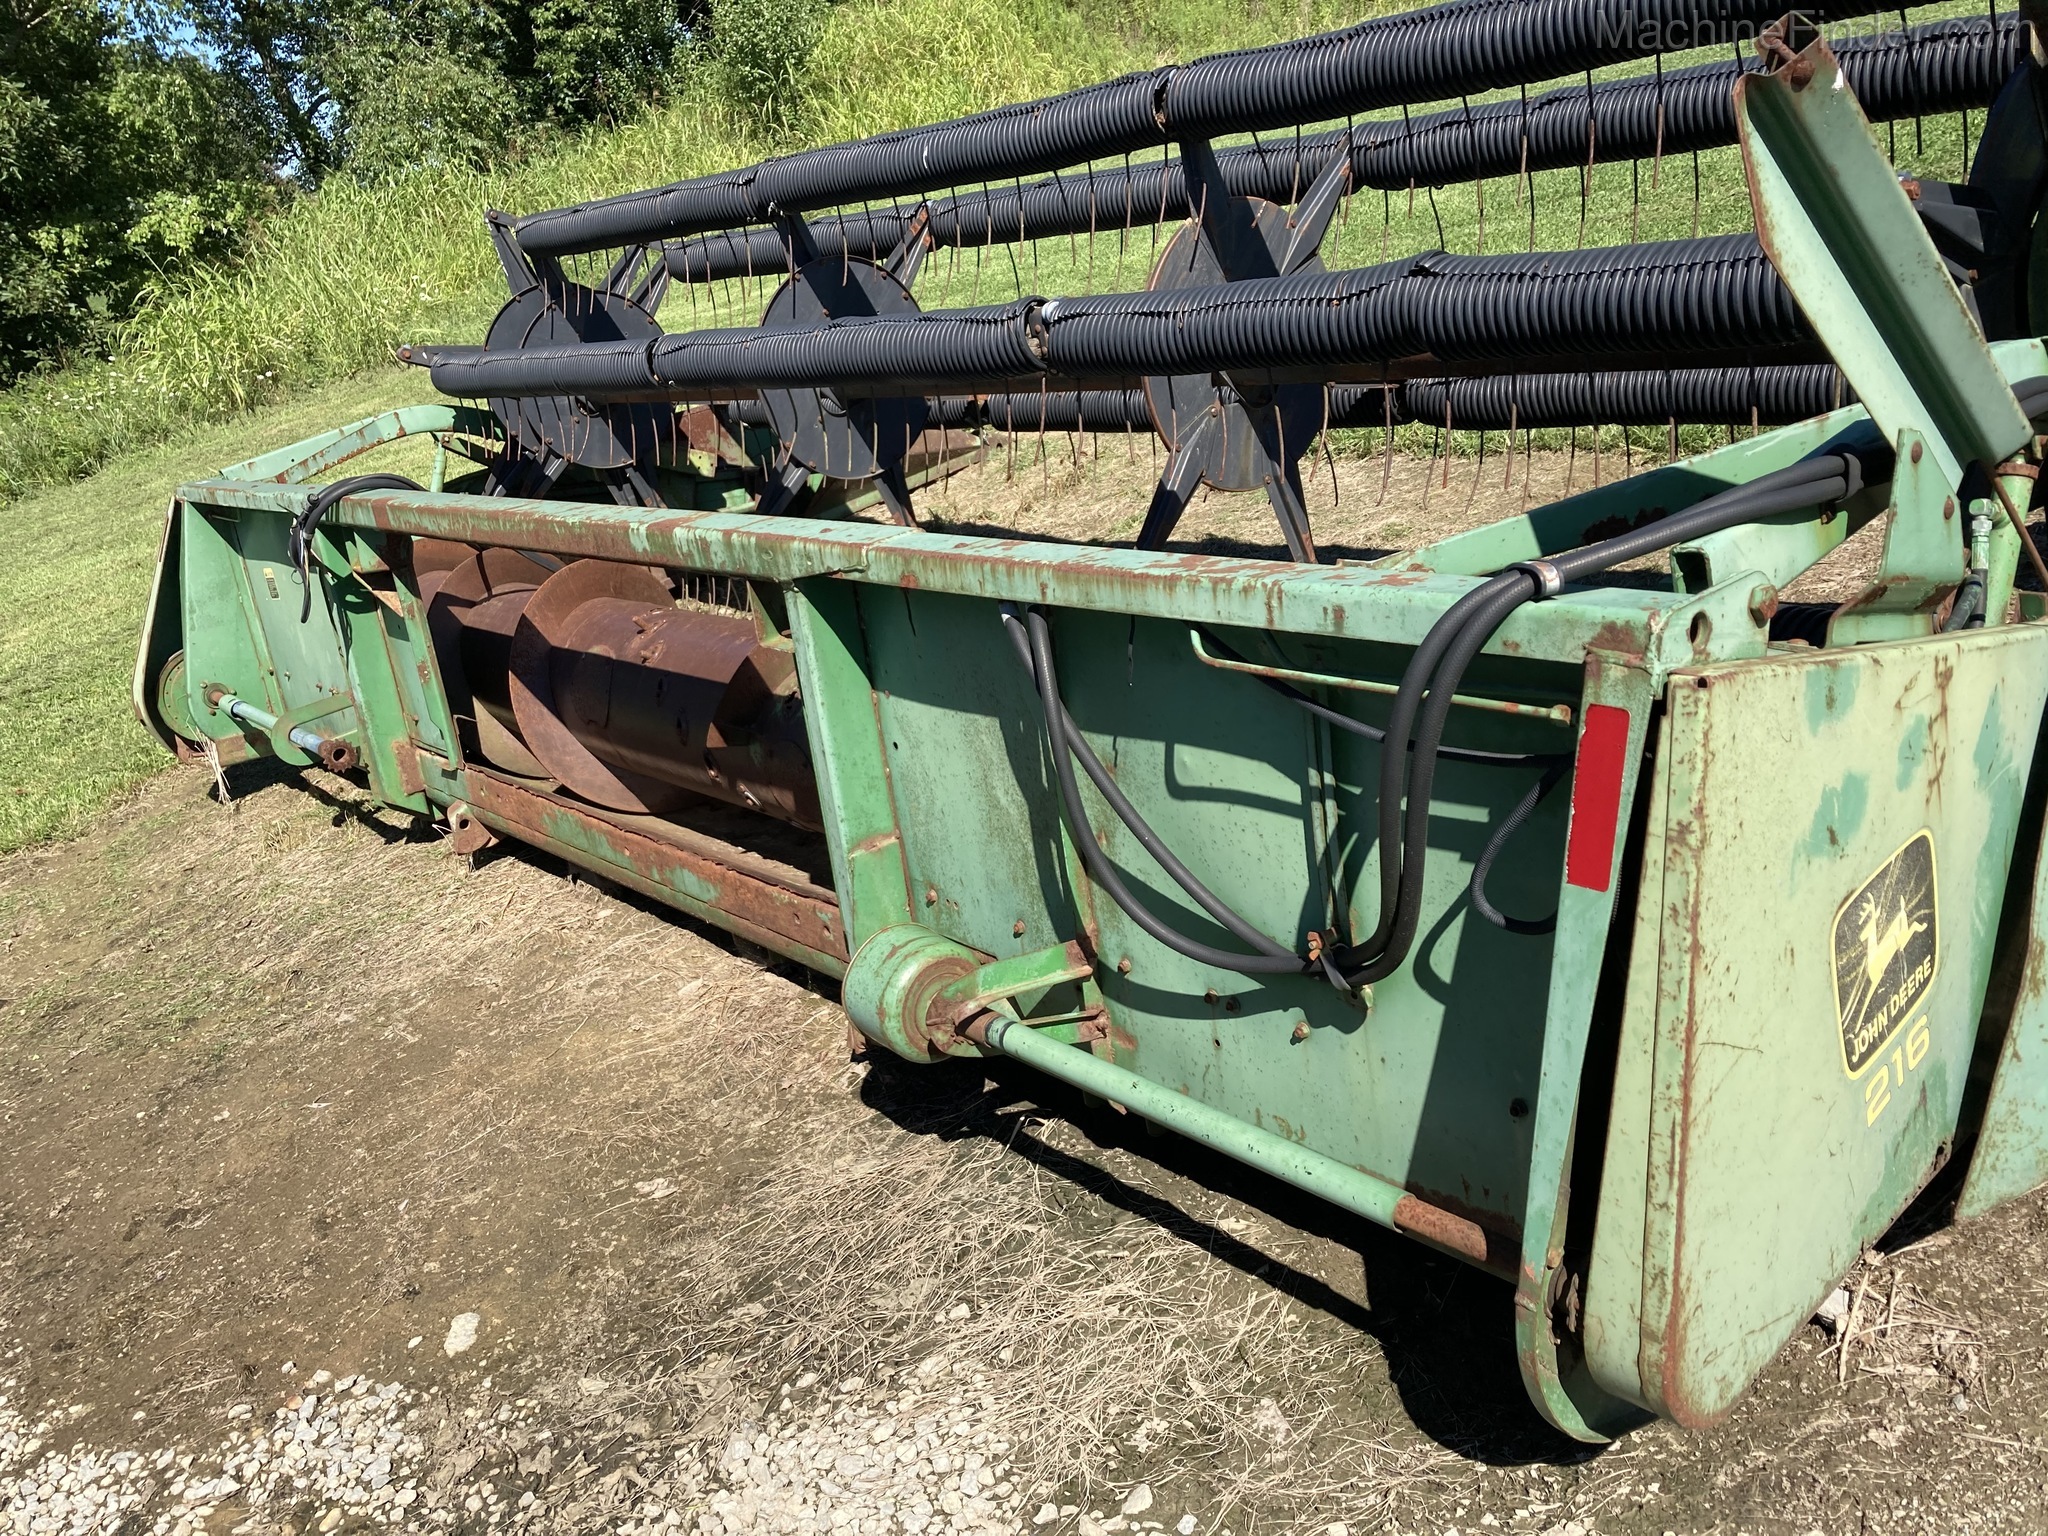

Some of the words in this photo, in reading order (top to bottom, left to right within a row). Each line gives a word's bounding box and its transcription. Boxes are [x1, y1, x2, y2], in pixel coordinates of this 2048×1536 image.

[1851, 1005, 1889, 1063] JOHN
[1891, 955, 1932, 1017] DEERE
[1865, 1014, 1930, 1127] 216
